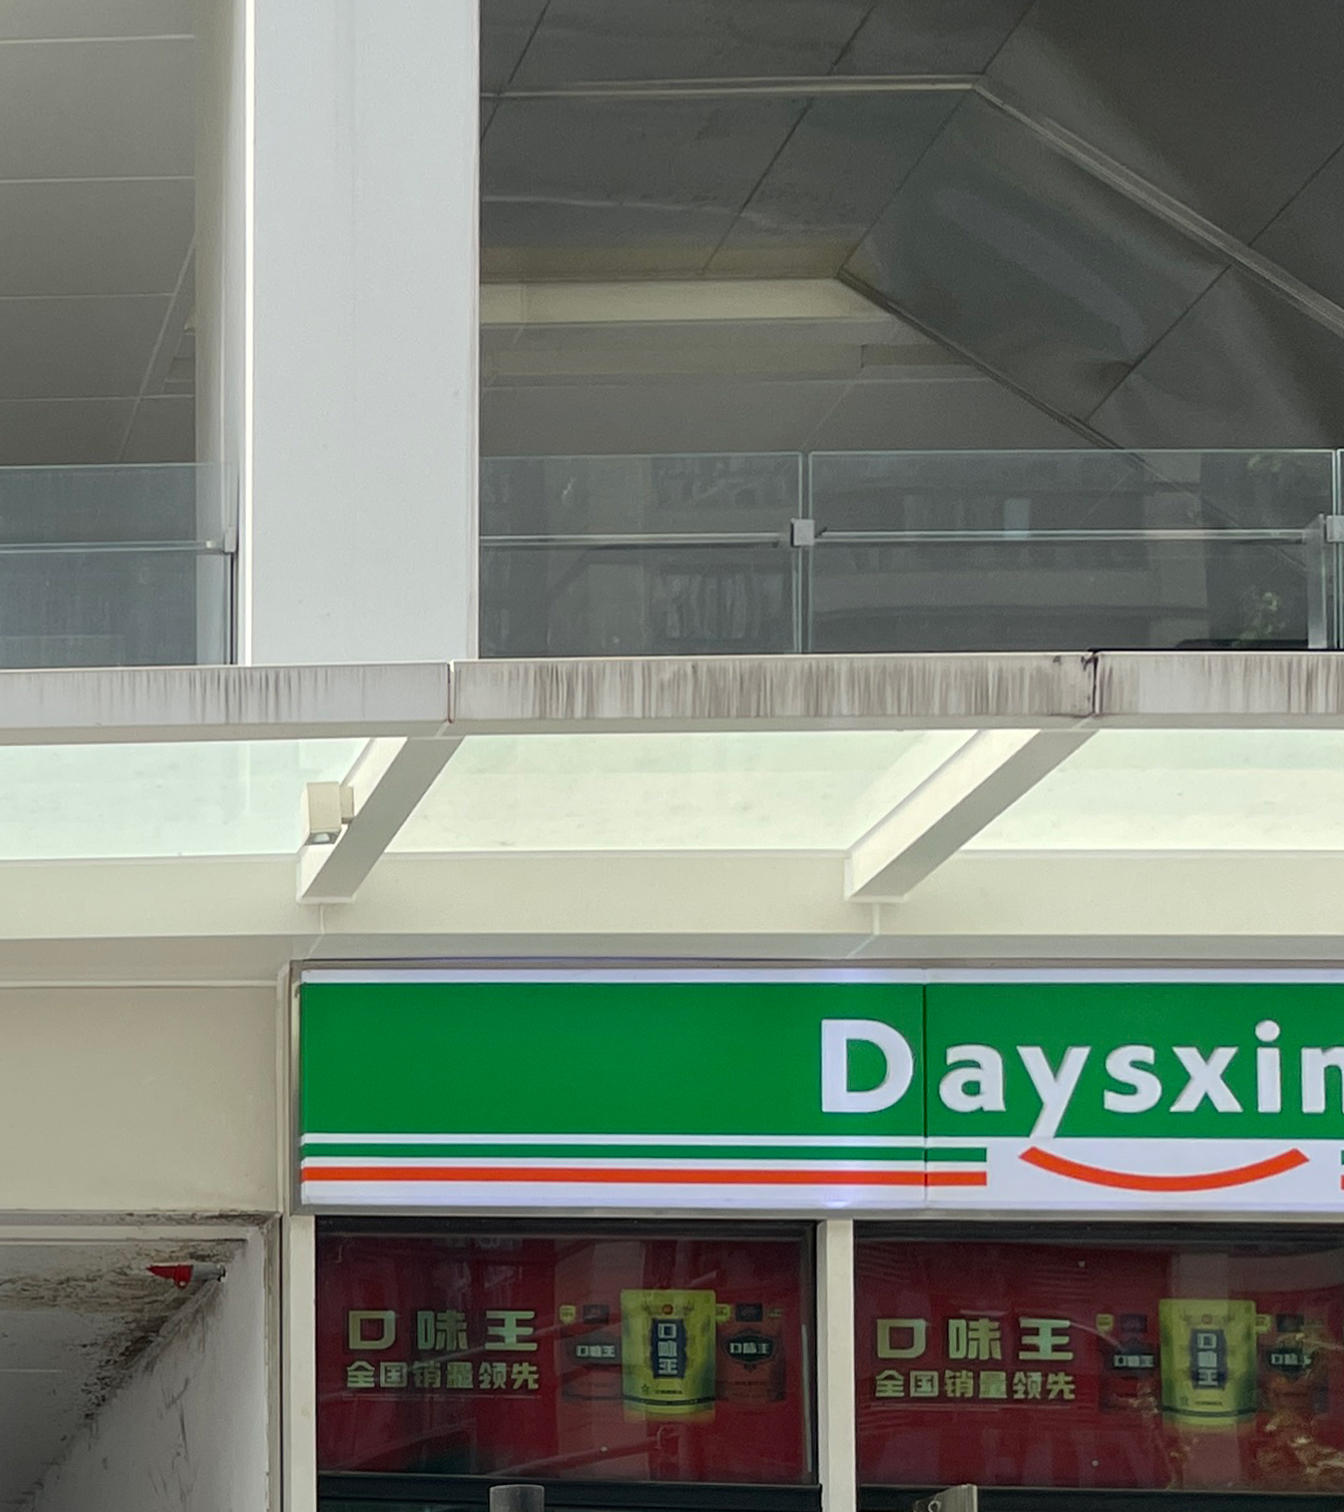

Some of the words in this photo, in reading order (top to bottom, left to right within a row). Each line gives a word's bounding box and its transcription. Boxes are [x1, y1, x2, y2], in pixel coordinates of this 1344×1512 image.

[348, 1309, 538, 1351] 口味王
[877, 1317, 1074, 1361] 口味王
[346, 1360, 540, 1390] 全国销量领先
[875, 1369, 1076, 1400] 全国销量领先
